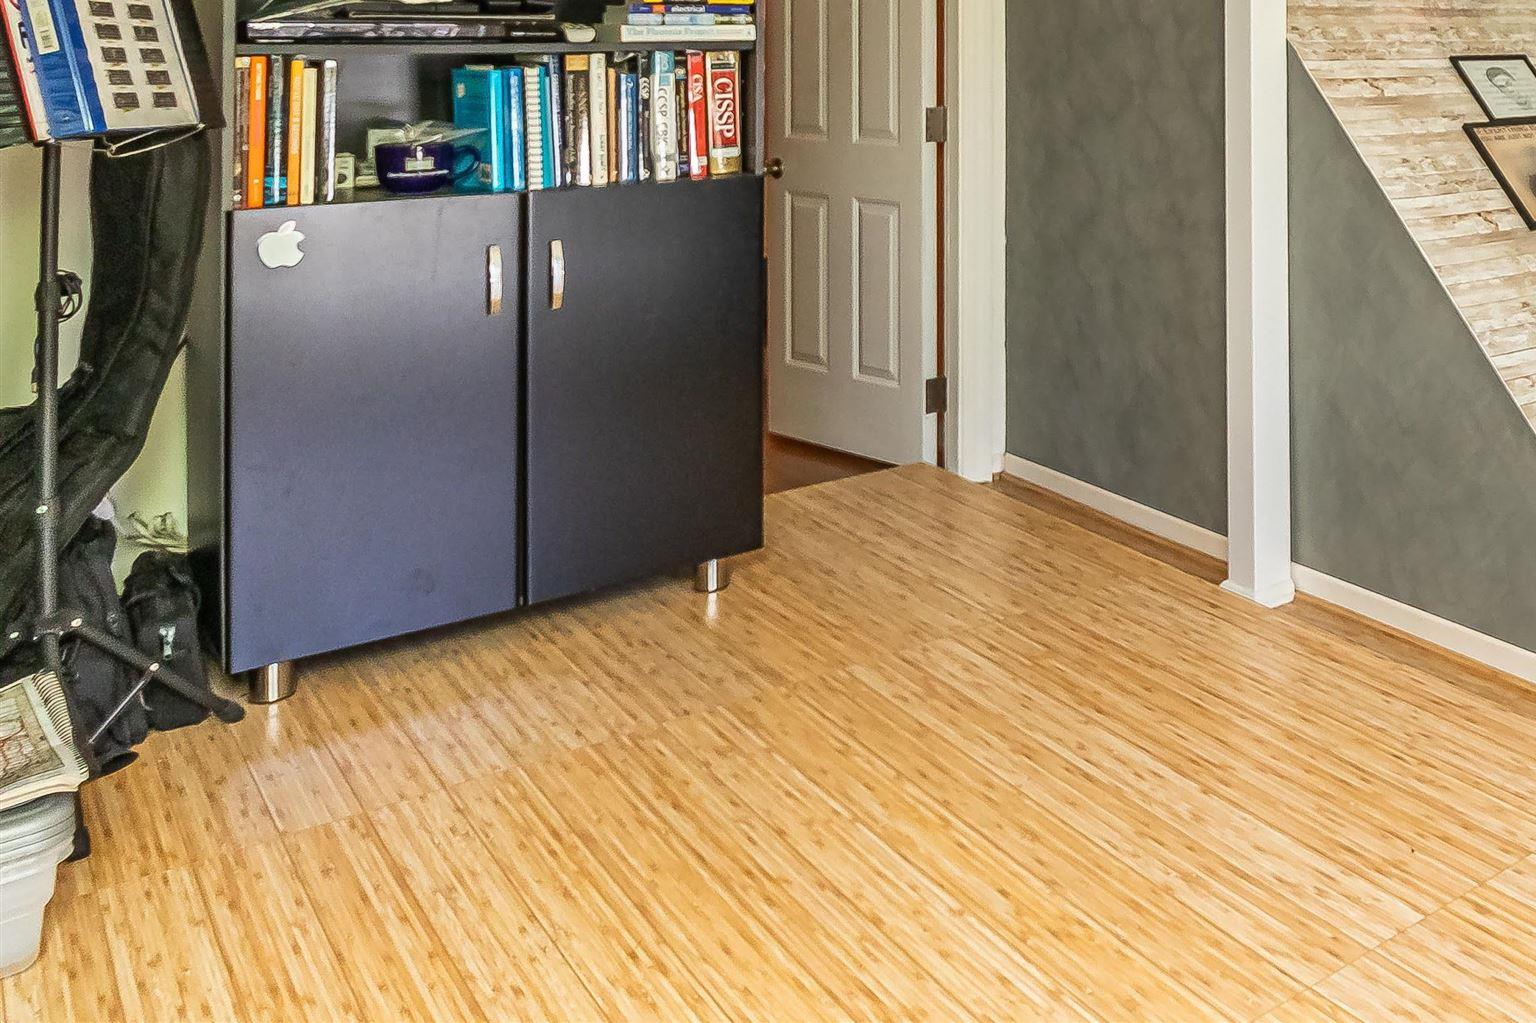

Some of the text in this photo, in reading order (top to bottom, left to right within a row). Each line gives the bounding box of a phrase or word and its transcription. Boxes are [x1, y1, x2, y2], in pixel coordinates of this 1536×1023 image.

[658, 87, 668, 117] CCSP
[692, 74, 704, 100] CISA
[713, 77, 735, 139] CISSP
